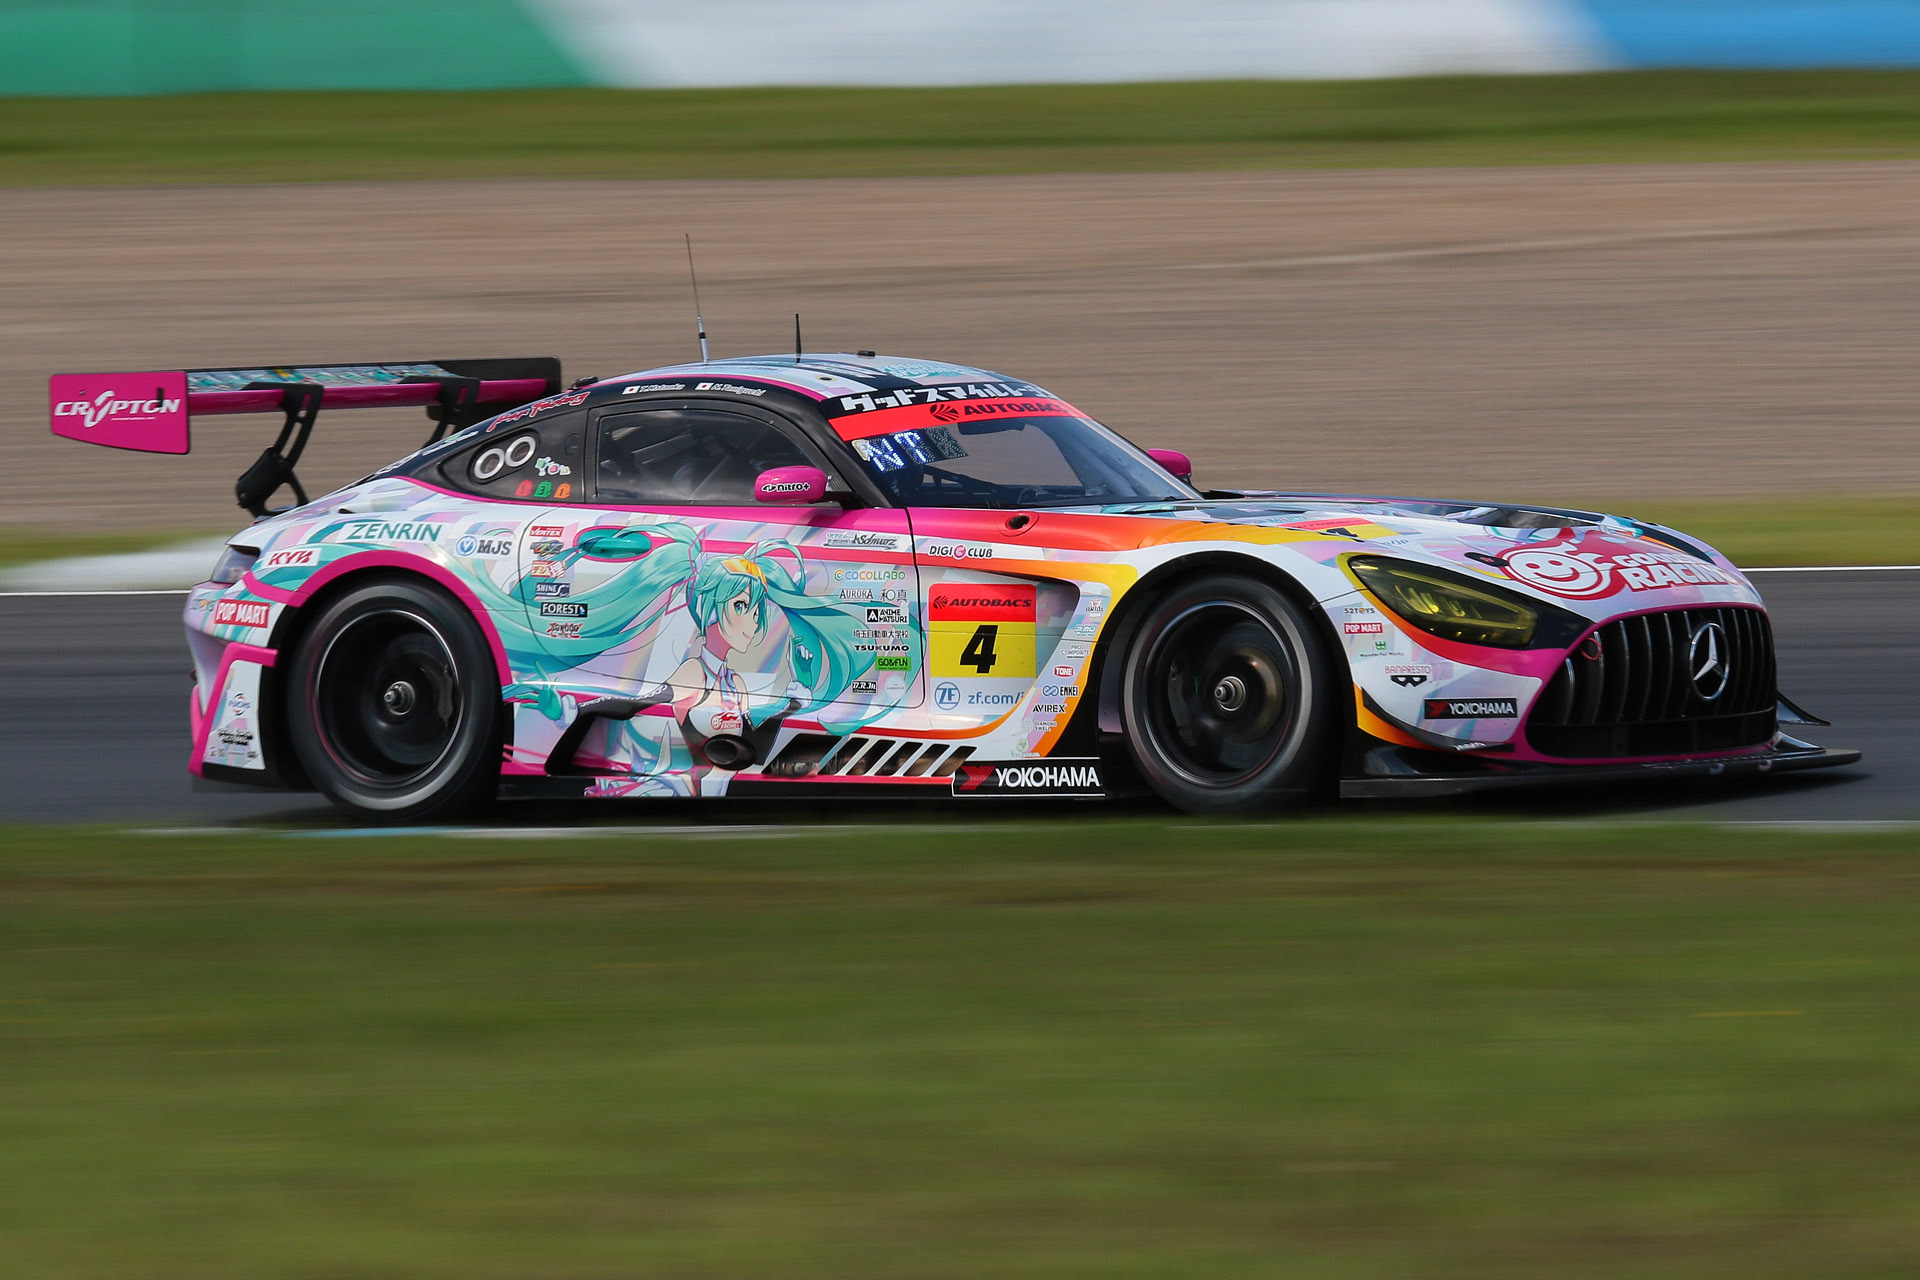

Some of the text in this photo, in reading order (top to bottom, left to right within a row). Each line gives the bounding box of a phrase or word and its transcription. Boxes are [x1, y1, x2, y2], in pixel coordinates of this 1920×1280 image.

[346, 522, 443, 542] ZENRIN
[476, 538, 513, 556] MJS
[929, 545, 993, 558] DIGI CLUB
[267, 550, 314, 566] KYB
[844, 570, 907, 581] COCOLLABO
[536, 583, 557, 593] SHINE
[839, 588, 874, 600] AURORA
[542, 603, 580, 614] FOREST
[948, 598, 1032, 608] AUTOBACS
[216, 602, 237, 622] POP
[235, 603, 269, 625] MART
[879, 608, 901, 616] ANIME
[1345, 623, 1382, 633] POP MART
[854, 644, 910, 652] TSUKUMO
[959, 624, 999, 674] 4
[877, 658, 908, 667] GO&FUN
[1055, 667, 1074, 676] TONE
[1384, 665, 1432, 674] BANPRESTO
[938, 687, 956, 705] ZF
[1060, 686, 1079, 696] ENKEI
[1032, 704, 1066, 713] AVIREX
[1447, 702, 1516, 715] YOKOHAMA
[995, 766, 1101, 788] YOKOHAMA
